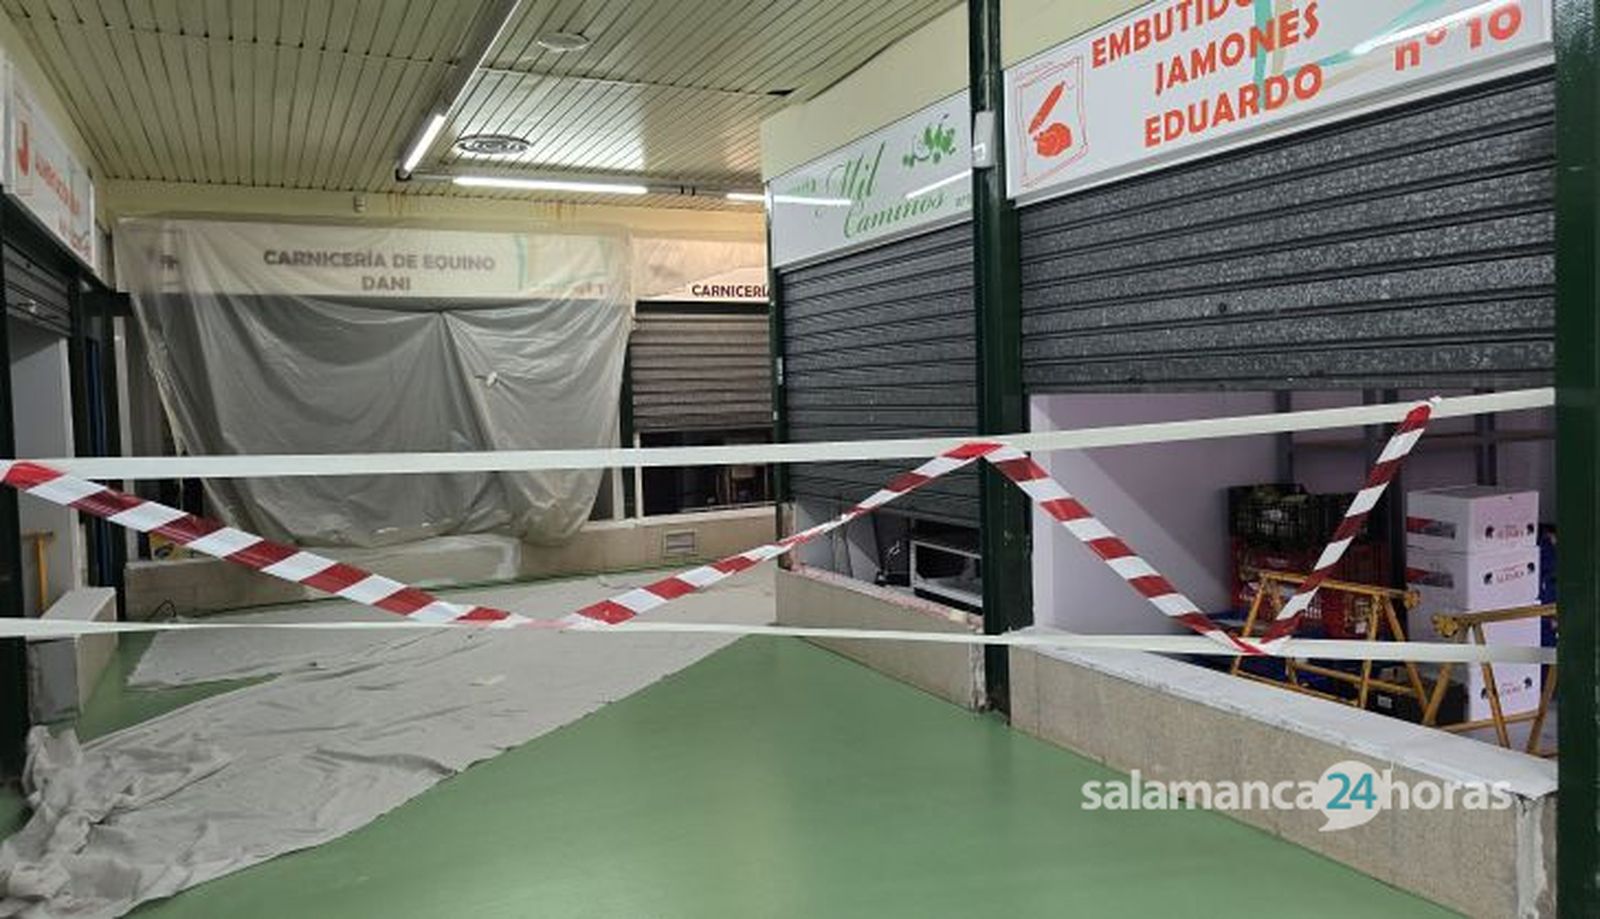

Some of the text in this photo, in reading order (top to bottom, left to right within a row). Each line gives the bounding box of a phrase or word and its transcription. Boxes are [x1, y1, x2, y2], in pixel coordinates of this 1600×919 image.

[1466, 4, 1522, 48] 10
[1155, 2, 1319, 96] JAMONES
[1144, 63, 1323, 148] EDUARDO
[263, 249, 496, 272] CARNICERÍA DE EQUINO
[361, 276, 411, 291] DANI
